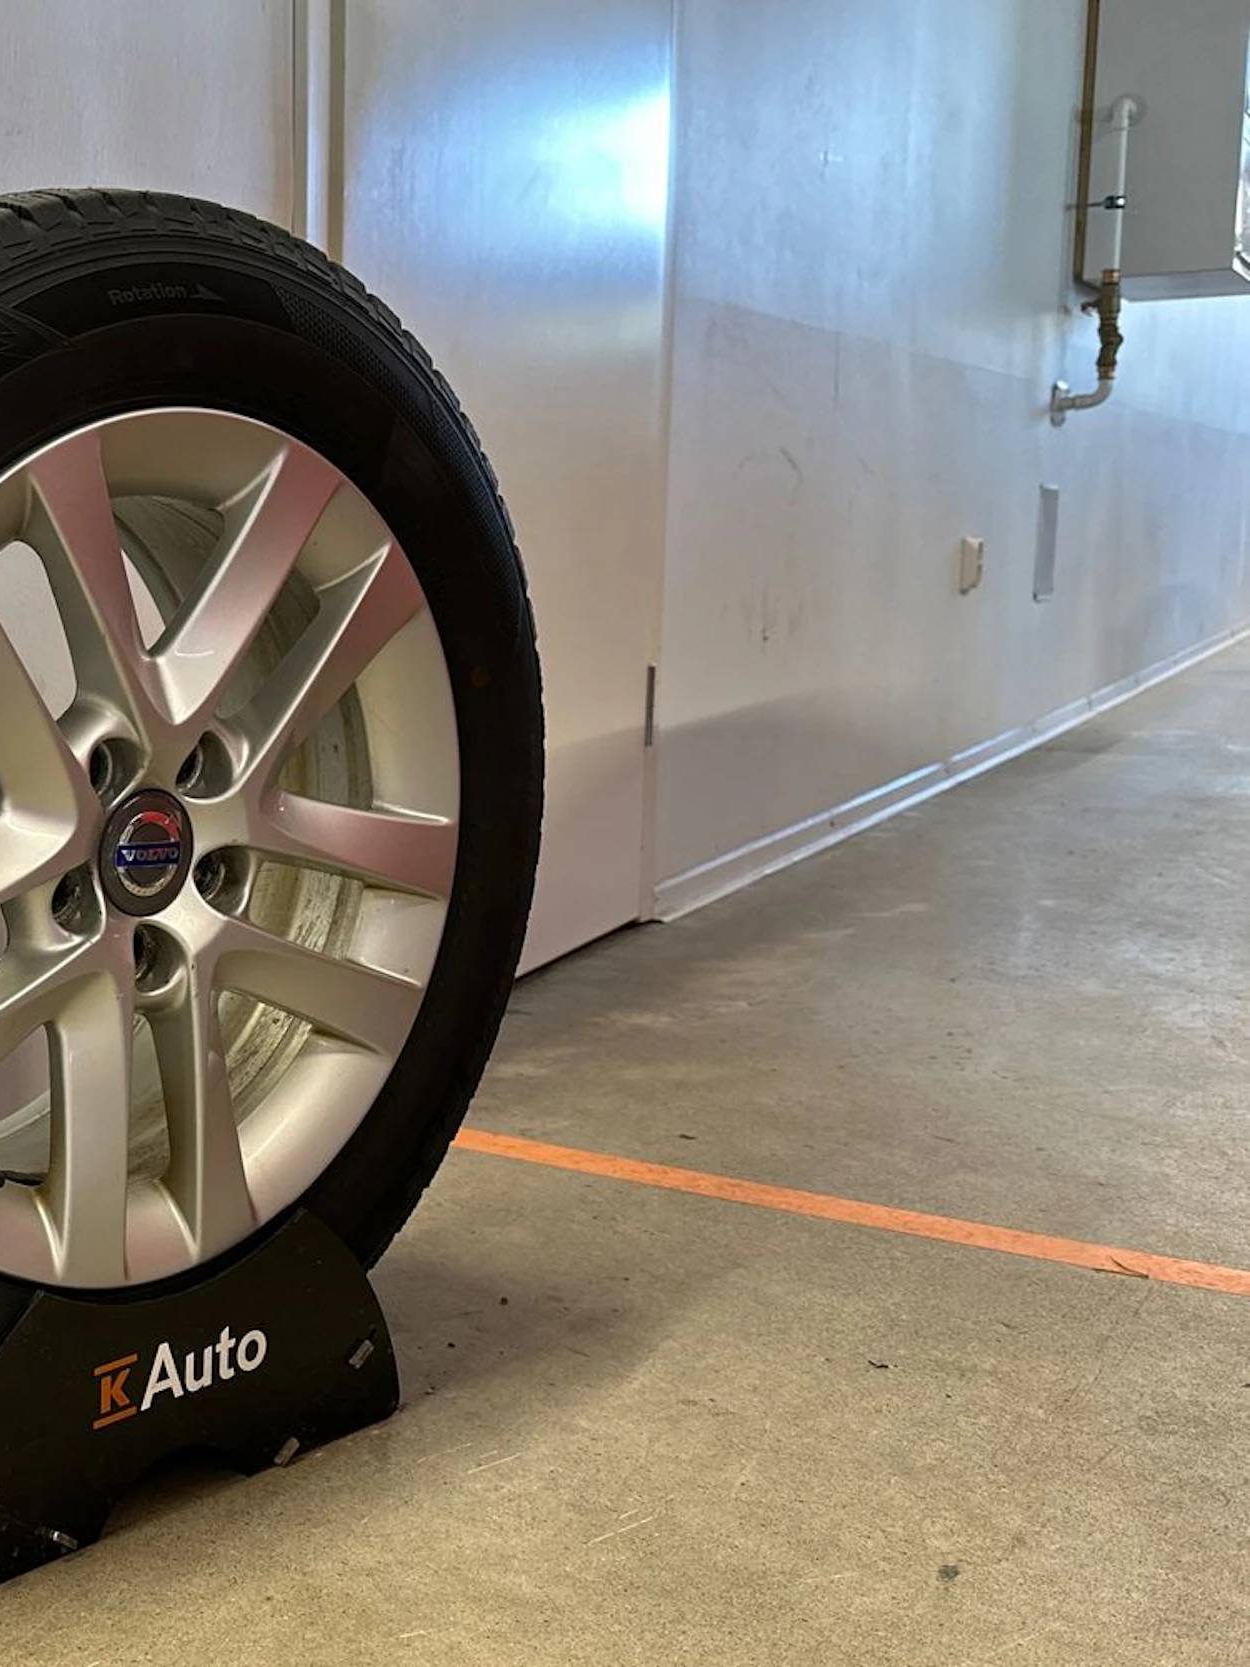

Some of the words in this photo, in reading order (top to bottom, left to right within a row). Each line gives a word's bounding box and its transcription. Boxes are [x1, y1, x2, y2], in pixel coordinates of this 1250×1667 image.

[107, 282, 188, 305] Rotation
[121, 847, 178, 862] VOLVO
[140, 1326, 268, 1411] Auto
